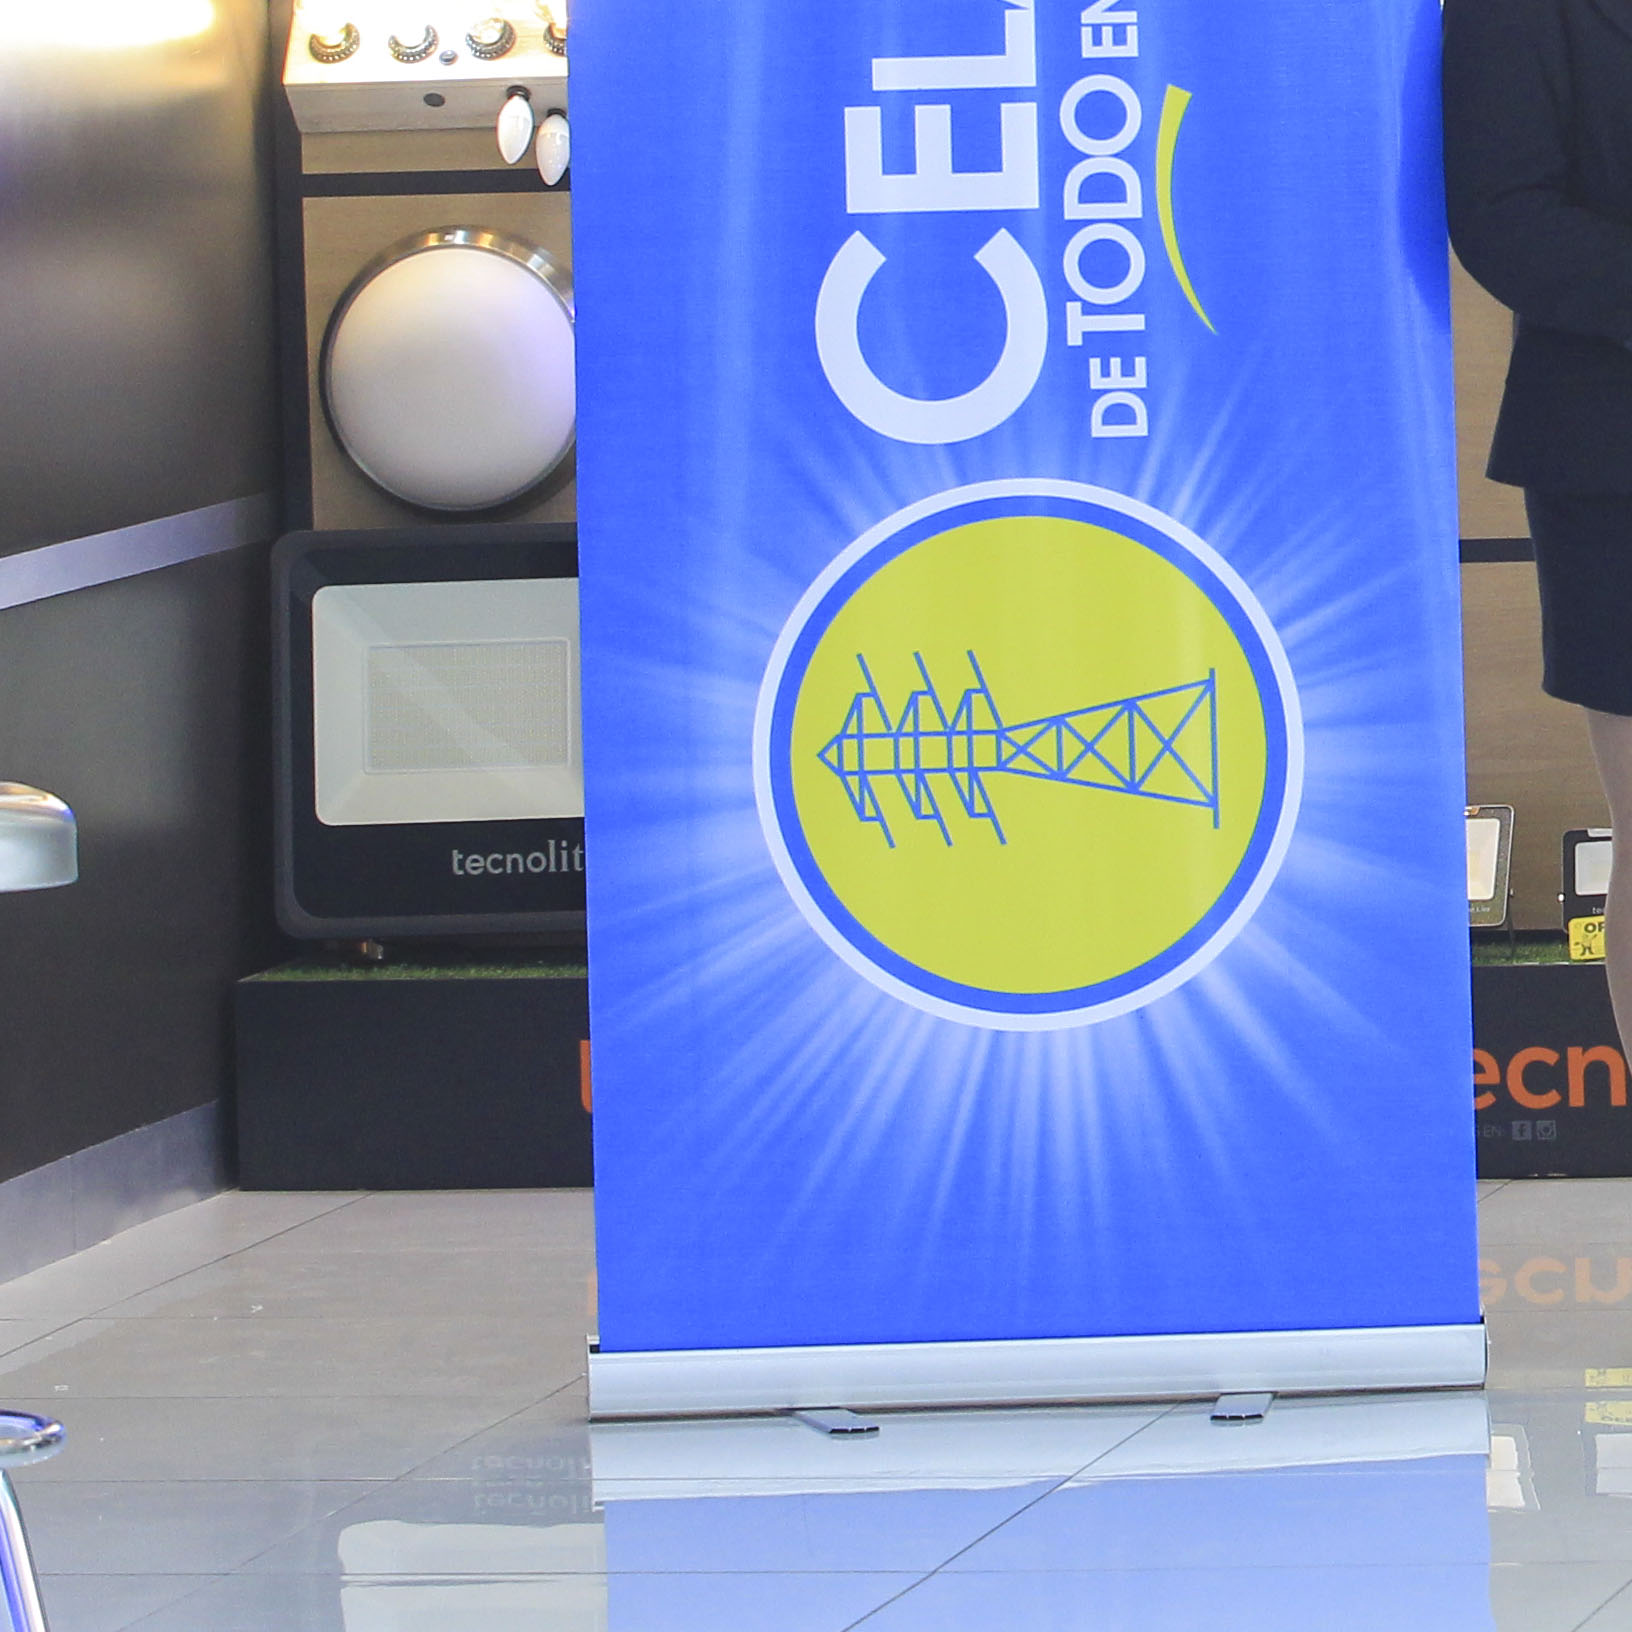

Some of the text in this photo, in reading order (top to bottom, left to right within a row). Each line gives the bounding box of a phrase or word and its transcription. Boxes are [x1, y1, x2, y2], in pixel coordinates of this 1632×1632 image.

[1059, 73, 1147, 346] TODO
[1091, 356, 1149, 438] DE
[452, 839, 585, 876] tecnolit
